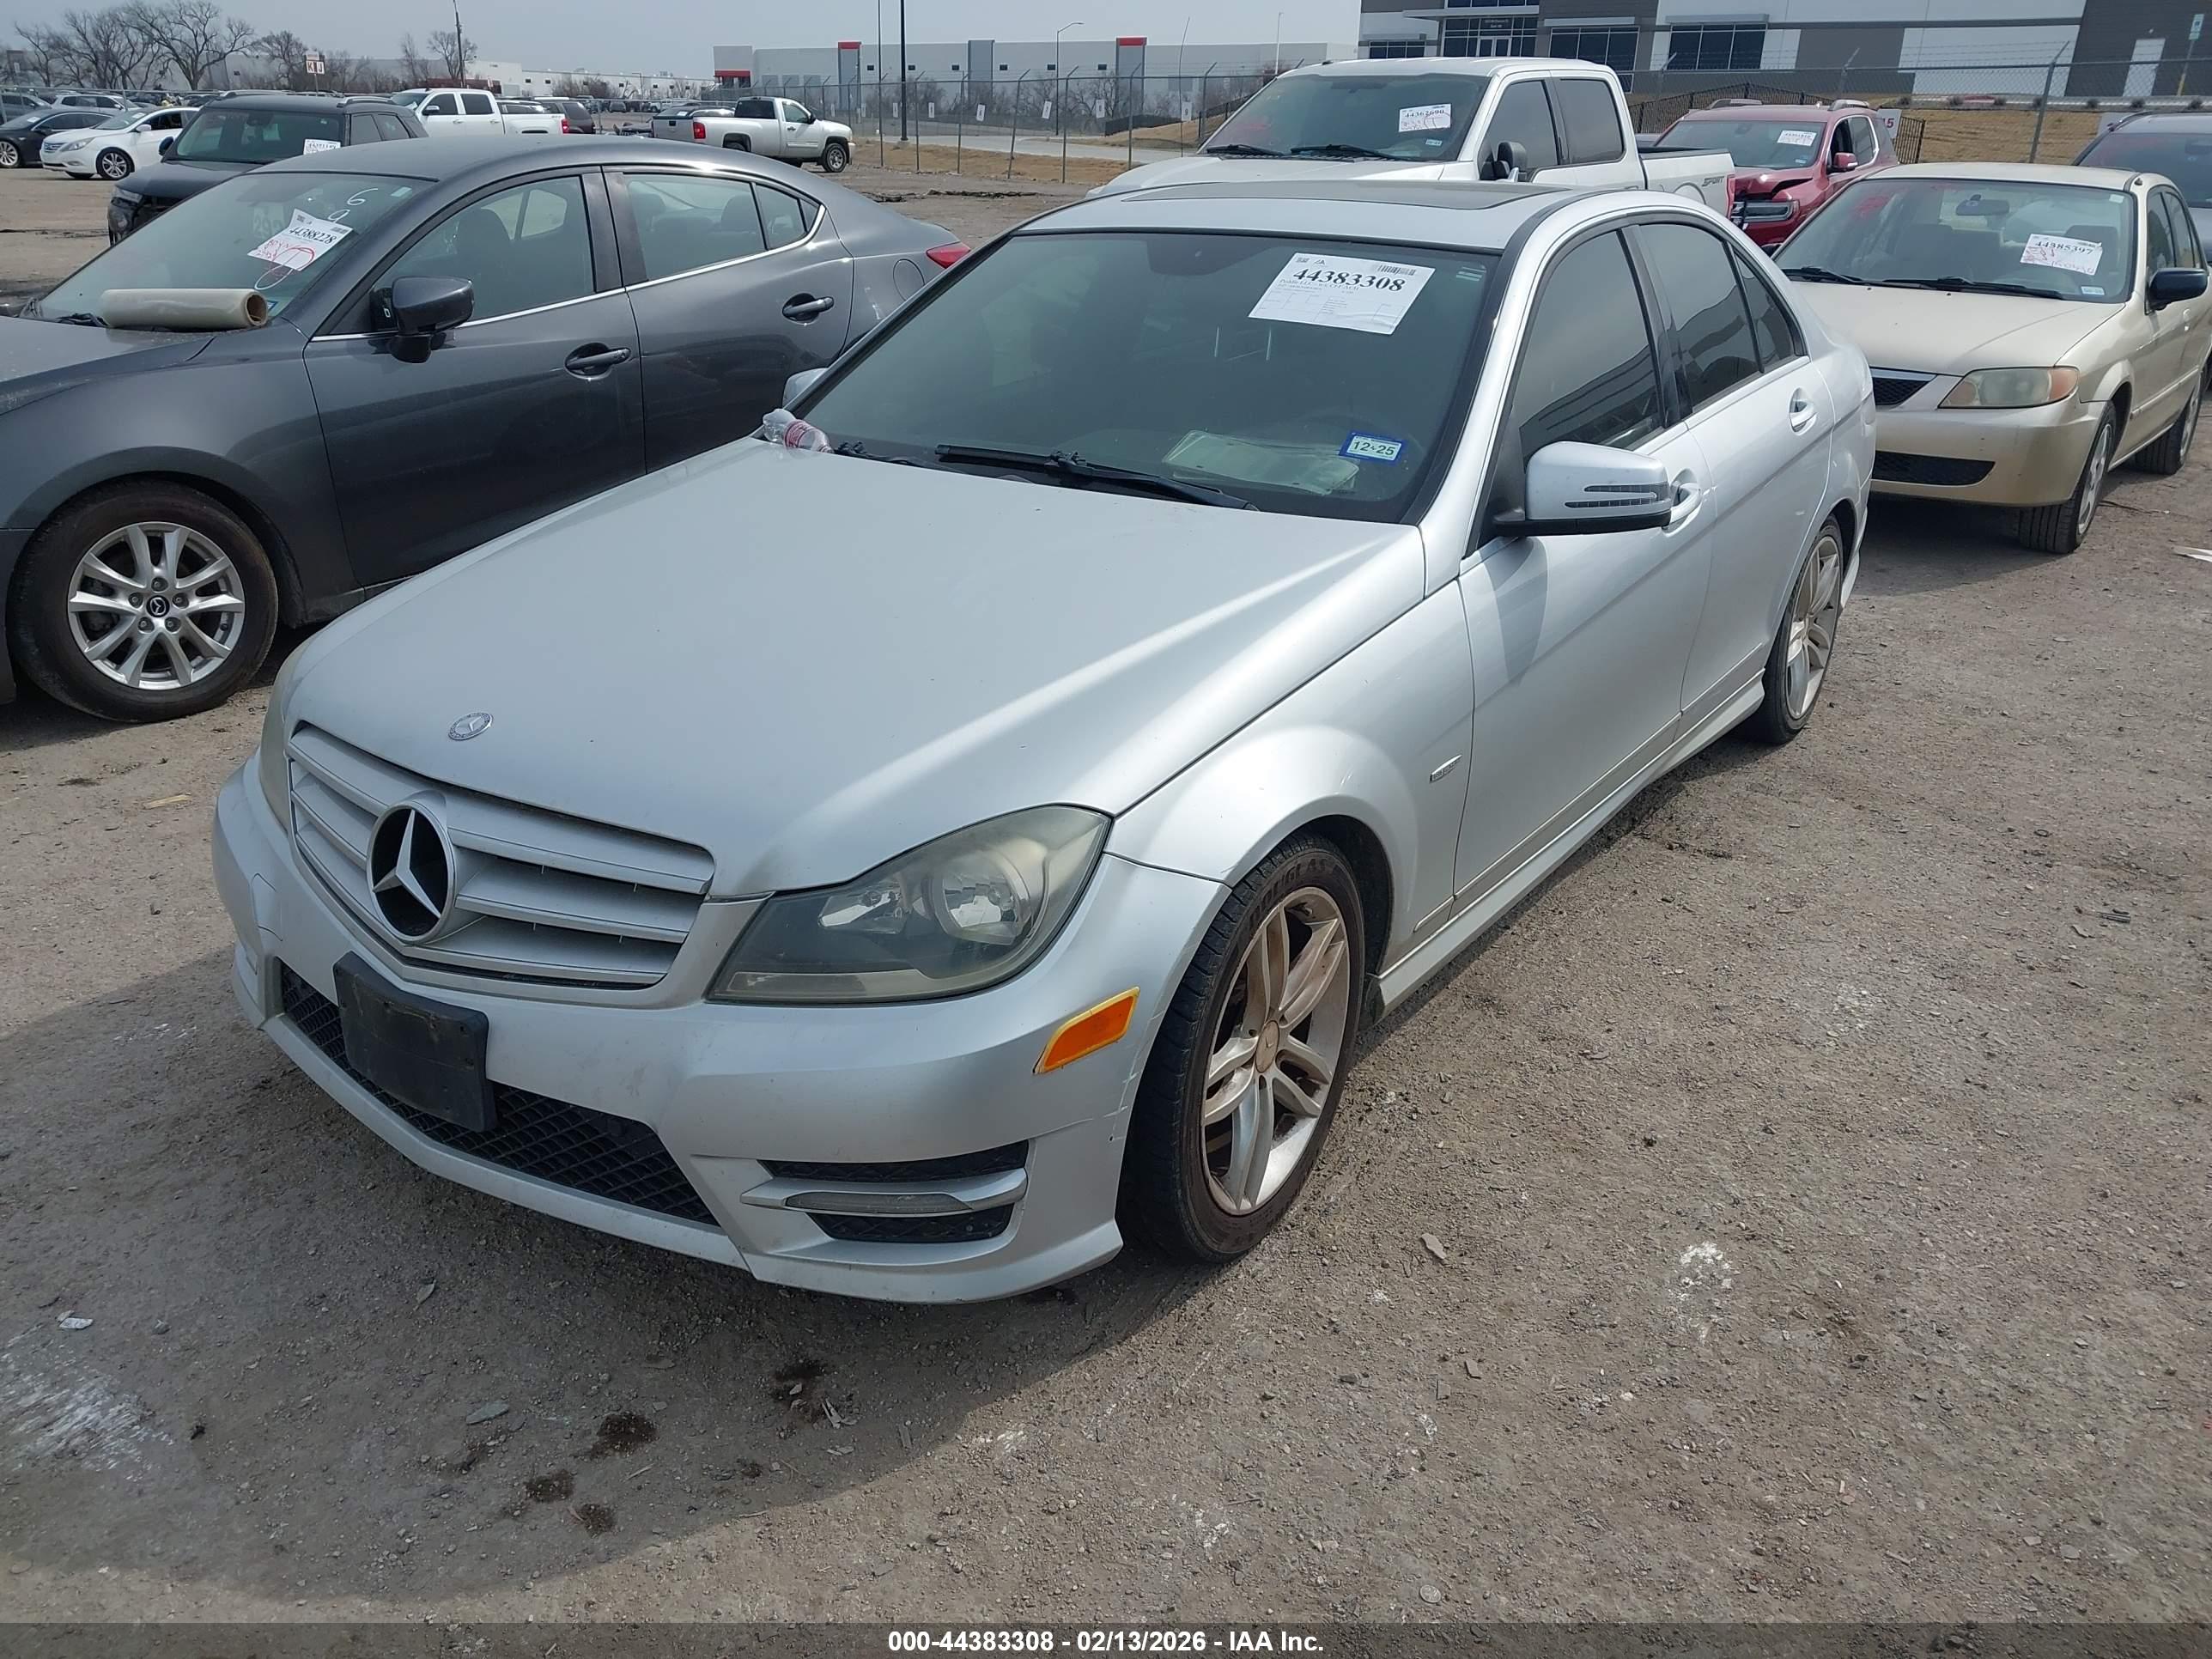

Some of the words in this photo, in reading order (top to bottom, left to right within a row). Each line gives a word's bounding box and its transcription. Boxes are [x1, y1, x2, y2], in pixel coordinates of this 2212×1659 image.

[289, 226, 337, 245] 44388228
[2035, 241, 2094, 255] 44385397
[1293, 268, 1406, 292] 44383308
